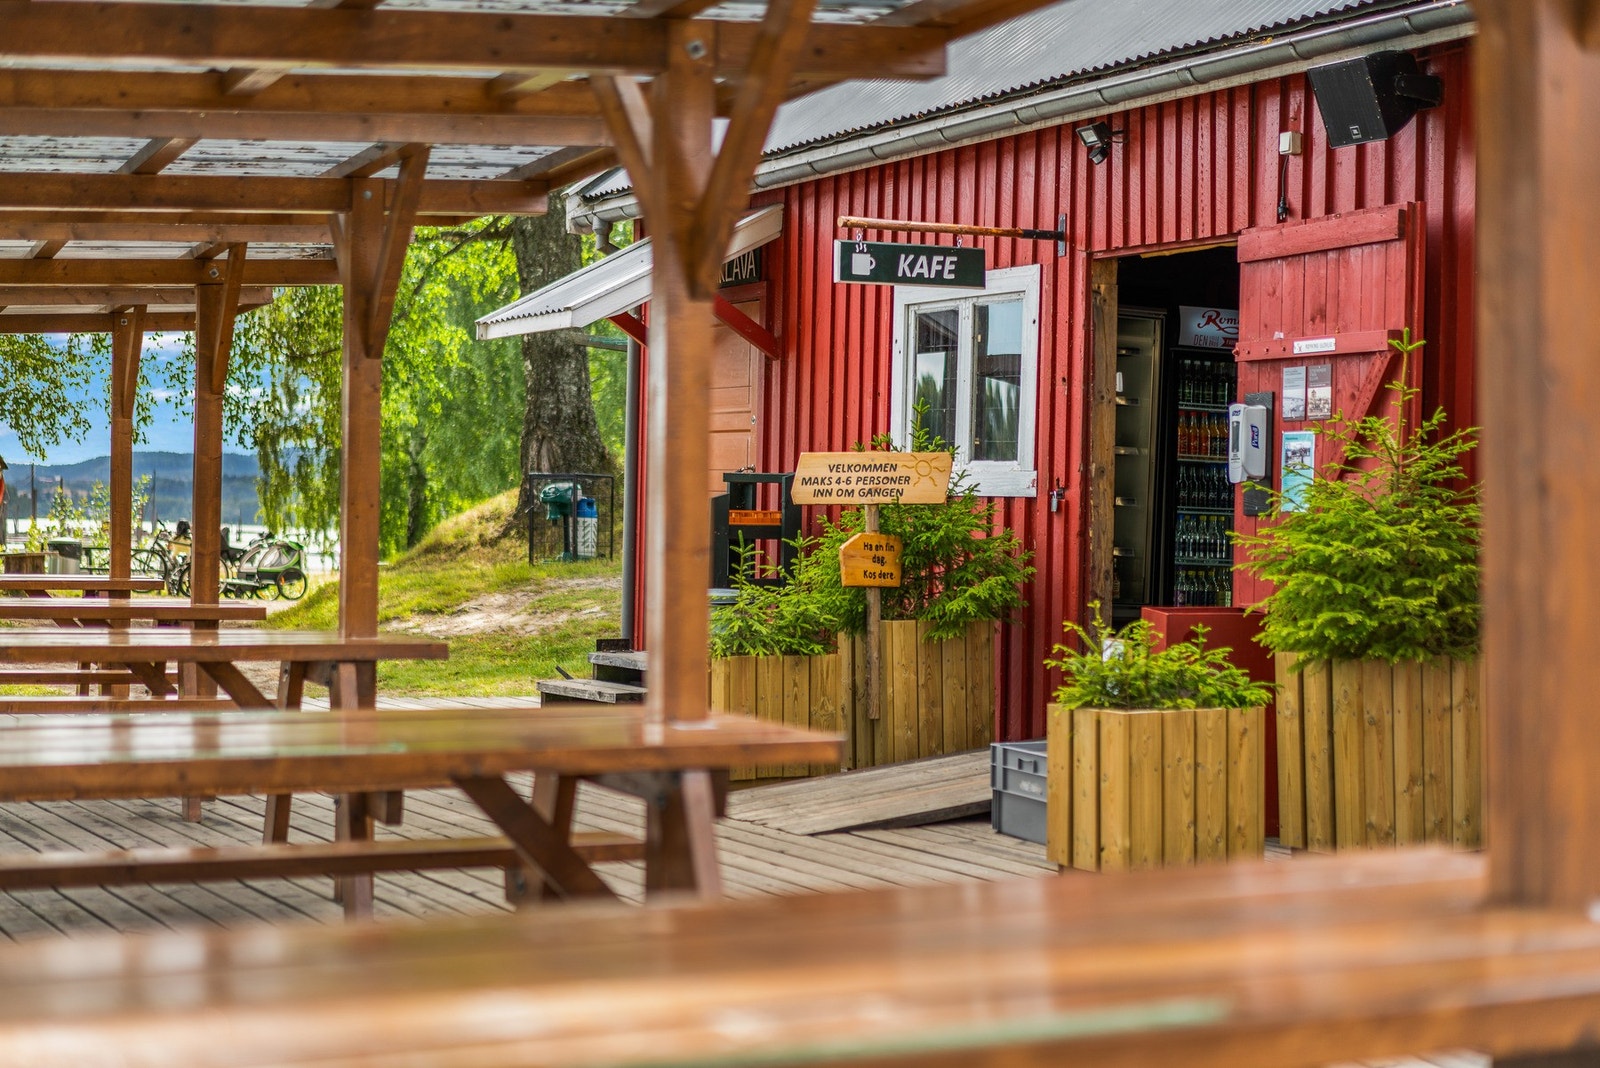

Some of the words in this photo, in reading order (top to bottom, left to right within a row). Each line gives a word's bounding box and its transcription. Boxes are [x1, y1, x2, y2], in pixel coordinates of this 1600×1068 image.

[898, 254, 958, 280] KAFE
[1197, 309, 1239, 334] Rom
[828, 463, 898, 473] VELKOMMEN
[801, 476, 833, 486] MAKS
[835, 476, 852, 486] 4-6
[856, 475, 911, 486] PERSONER
[812, 488, 833, 498] INN
[836, 488, 855, 498] OM
[858, 487, 904, 498] GANGEN
[863, 542, 873, 552] Ha
[874, 543, 884, 552] en
[885, 542, 895, 552] fin
[863, 569, 877, 579] Kos
